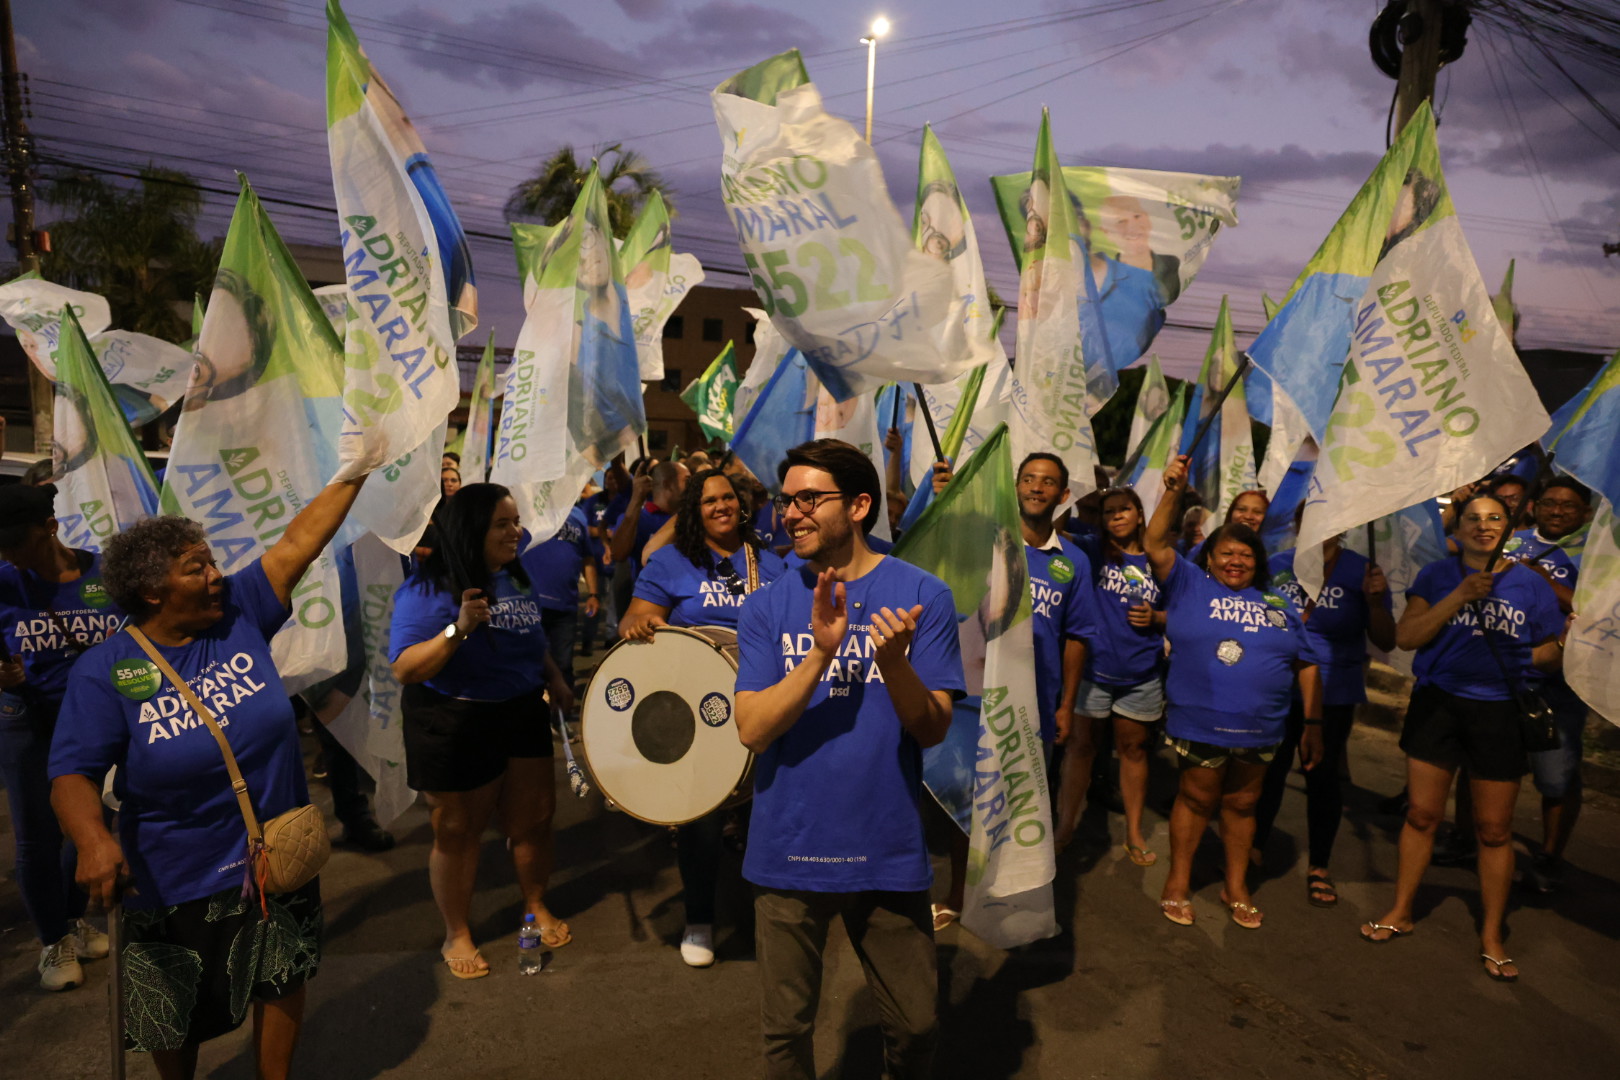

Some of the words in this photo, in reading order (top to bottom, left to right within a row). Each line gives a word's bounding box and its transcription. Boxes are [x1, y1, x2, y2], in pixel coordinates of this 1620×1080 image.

[734, 192, 858, 244] MARAL
[1377, 280, 1480, 437] ADRIANO
[1423, 294, 1453, 343] DEPUTADO
[1449, 340, 1471, 380] FEDERAL
[511, 350, 535, 461] ADRIANO
[1354, 302, 1442, 458] AMARAL
[219, 447, 335, 629] ADRINO
[490, 600, 538, 614] DRIANO
[849, 624, 879, 632] FEDER
[117, 668, 133, 680] 55
[132, 667, 148, 677] PRA
[117, 673, 156, 686] RESOLVE
[829, 686, 850, 698] psd
[704, 701, 719, 723] 5522
[982, 686, 1045, 847] ADRIANO
[1018, 706, 1037, 755] DEPUTADO
[1031, 757, 1048, 796] FEDERAL
